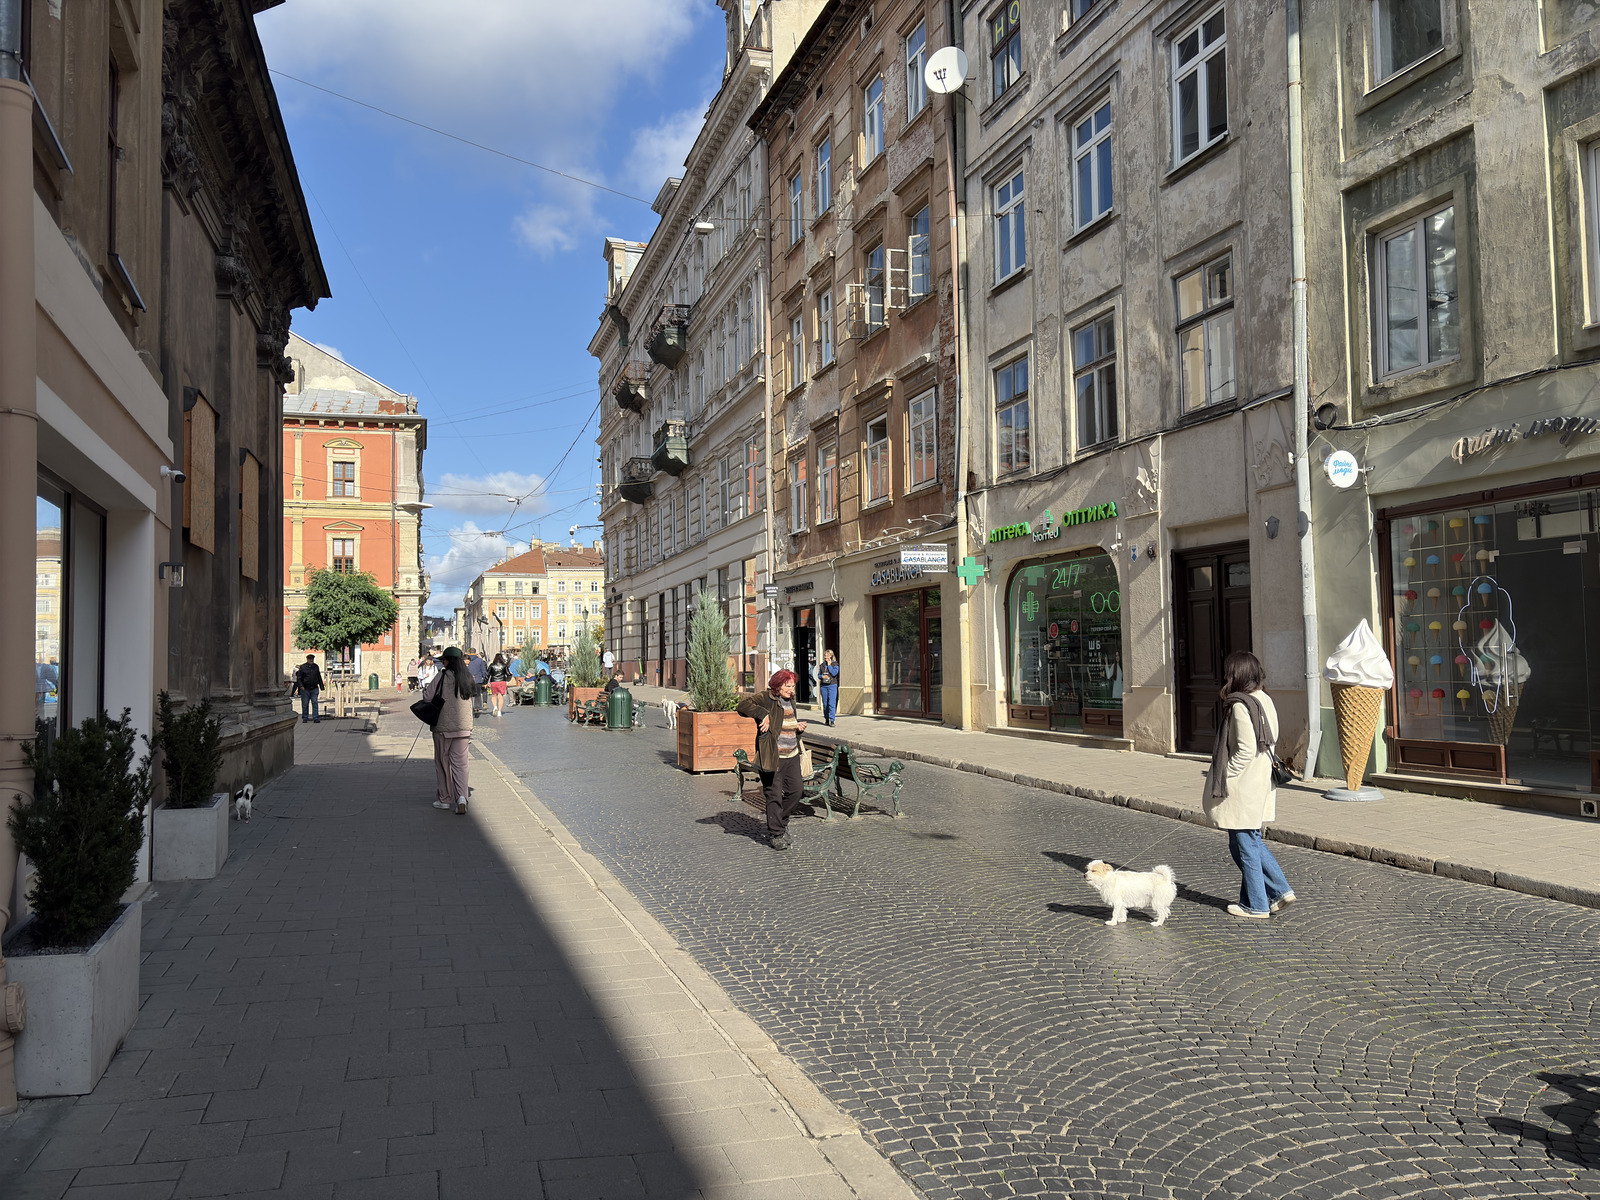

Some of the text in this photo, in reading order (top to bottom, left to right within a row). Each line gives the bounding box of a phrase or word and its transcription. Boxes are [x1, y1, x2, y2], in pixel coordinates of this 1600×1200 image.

[1451, 416, 1598, 464] Файні люди
[1333, 460, 1353, 468] Файні
[1333, 467, 1353, 476] люди
[1062, 501, 1117, 527] ОПТИКА
[1033, 527, 1061, 542] biomed
[871, 564, 923, 587] CASABLANCA
[1052, 563, 1080, 589] 24/7
